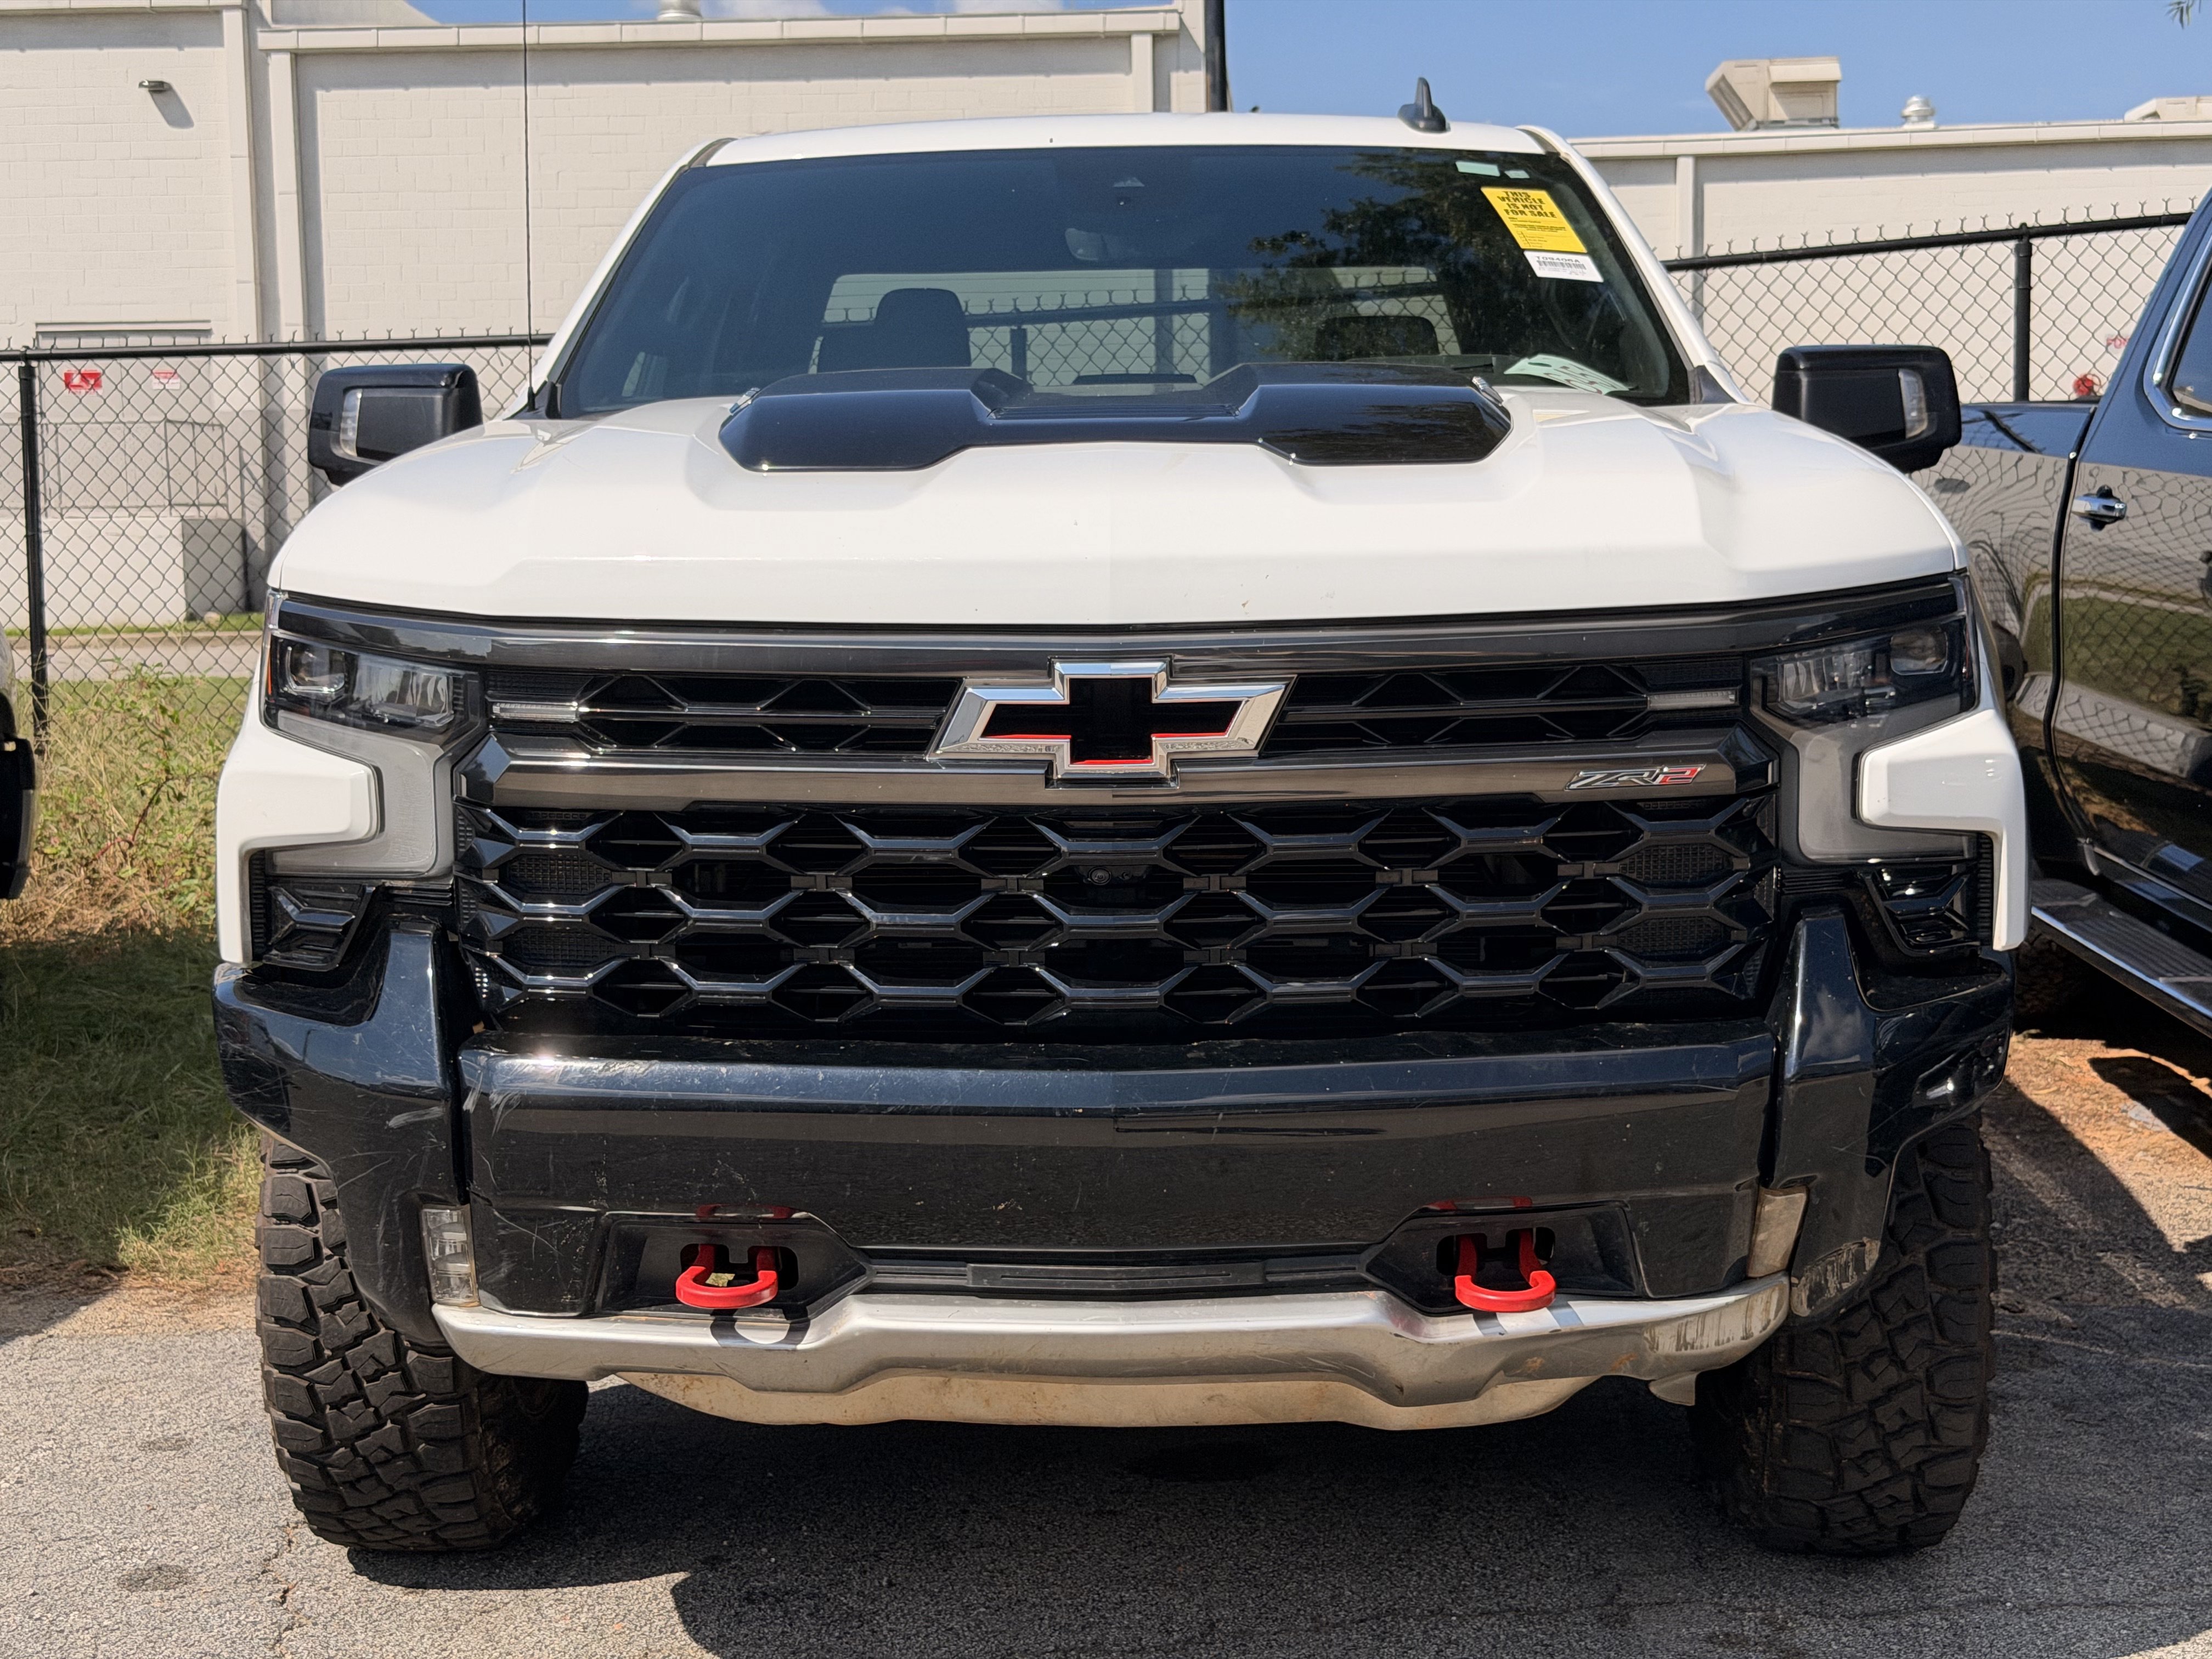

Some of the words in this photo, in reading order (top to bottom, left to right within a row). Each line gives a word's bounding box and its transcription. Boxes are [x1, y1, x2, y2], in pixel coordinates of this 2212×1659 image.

[1497, 196, 1545, 204] VEHICLE
[1503, 208, 1528, 216] FOR
[1528, 210, 1557, 218] SALE
[1565, 764, 1705, 790] ZR2
